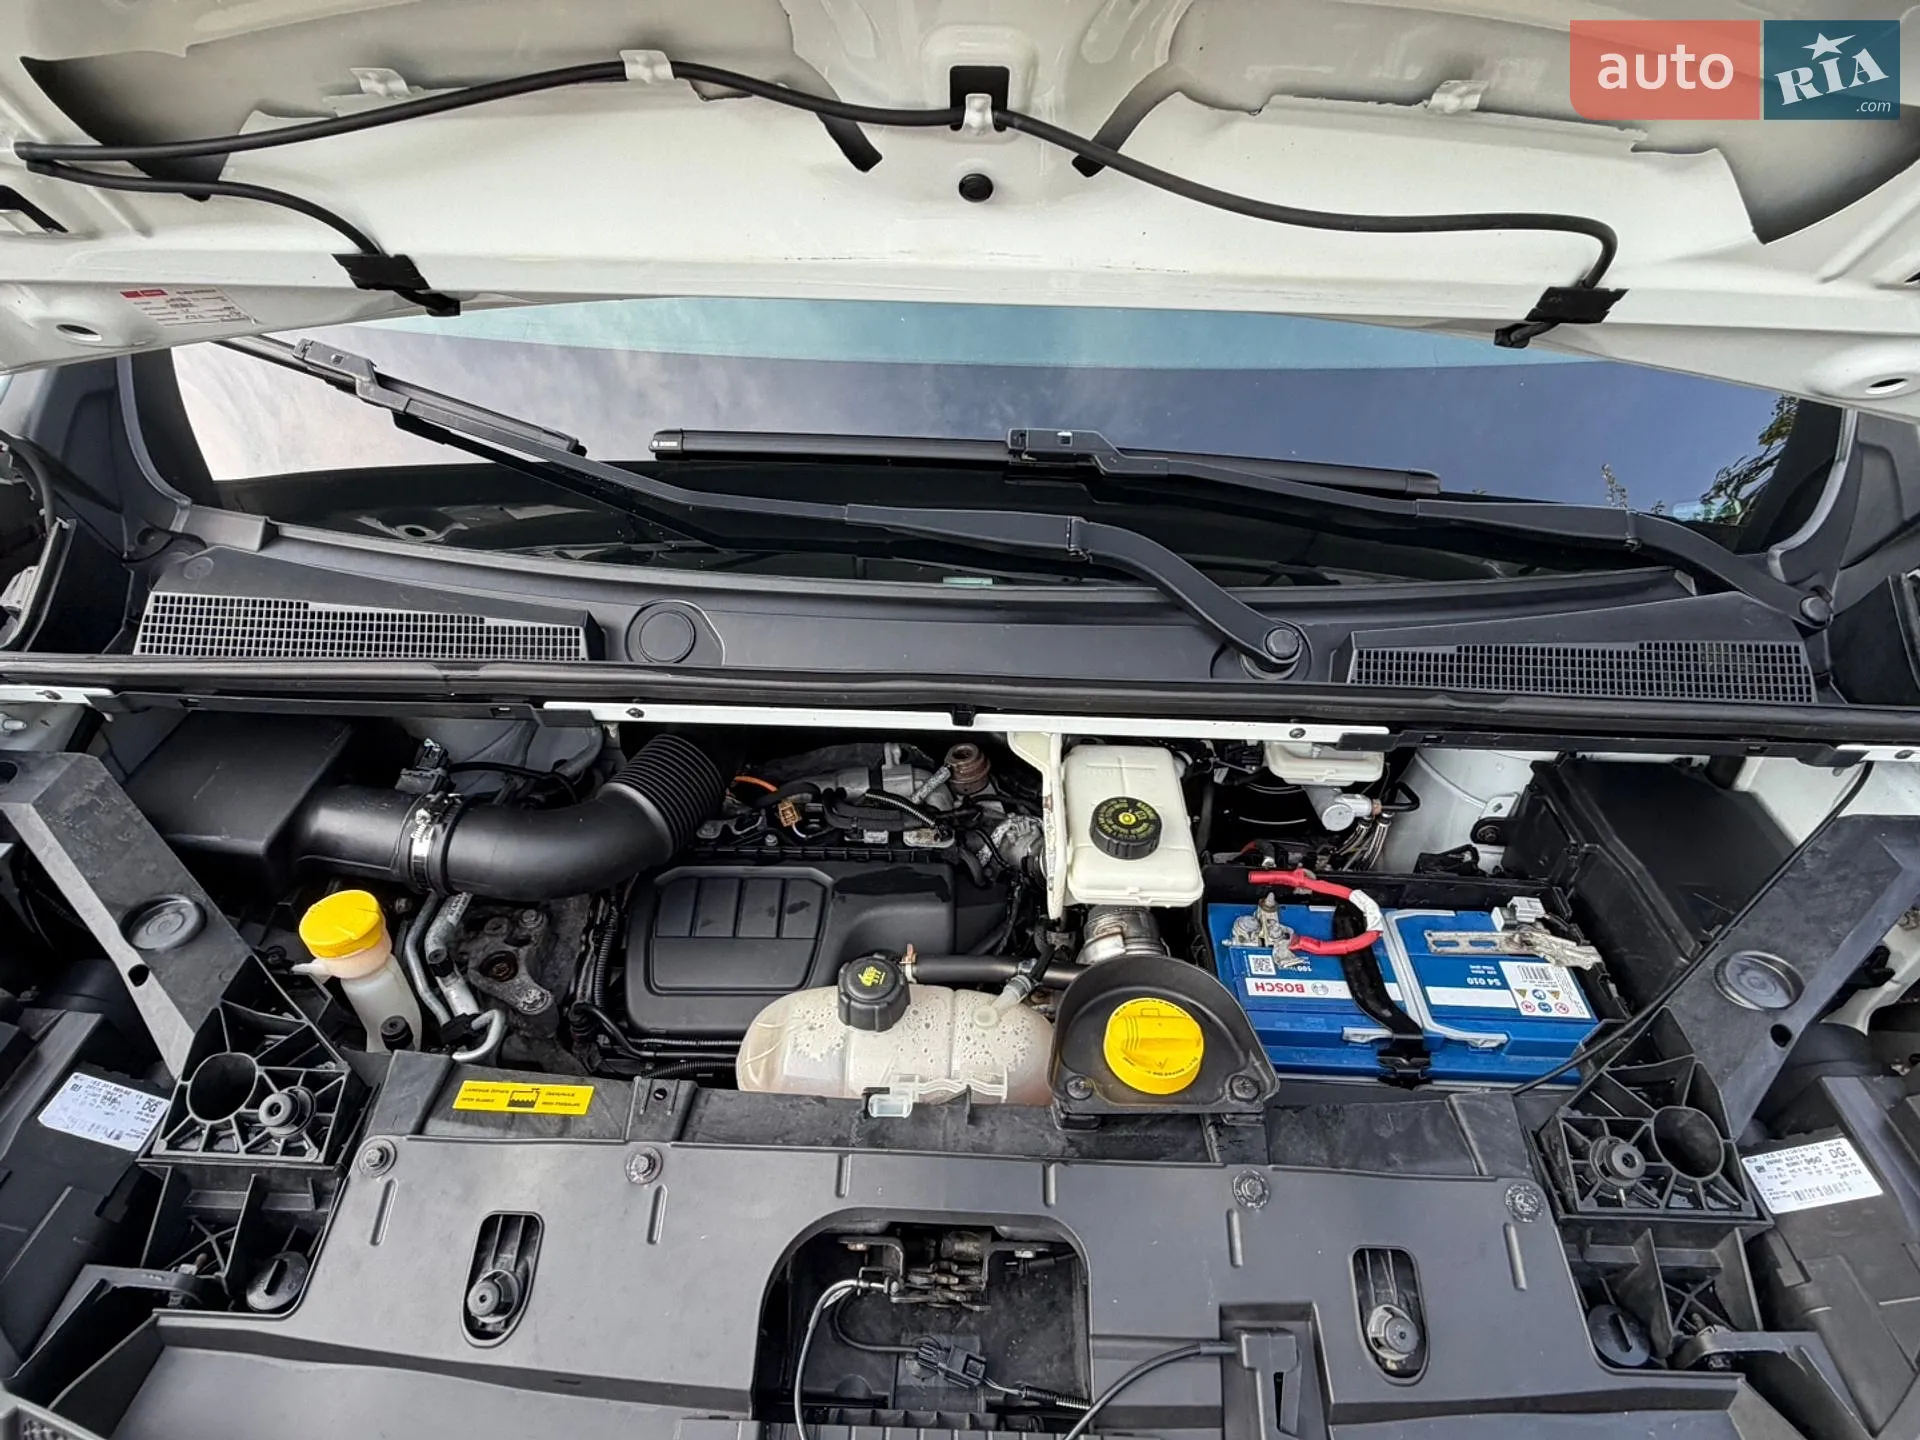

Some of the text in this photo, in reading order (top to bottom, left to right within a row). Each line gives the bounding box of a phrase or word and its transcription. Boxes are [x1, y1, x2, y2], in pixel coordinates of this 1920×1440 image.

[1254, 982, 1305, 993] BOSCH
[142, 1101, 159, 1113] DG
[1828, 1147, 1847, 1159] DG
